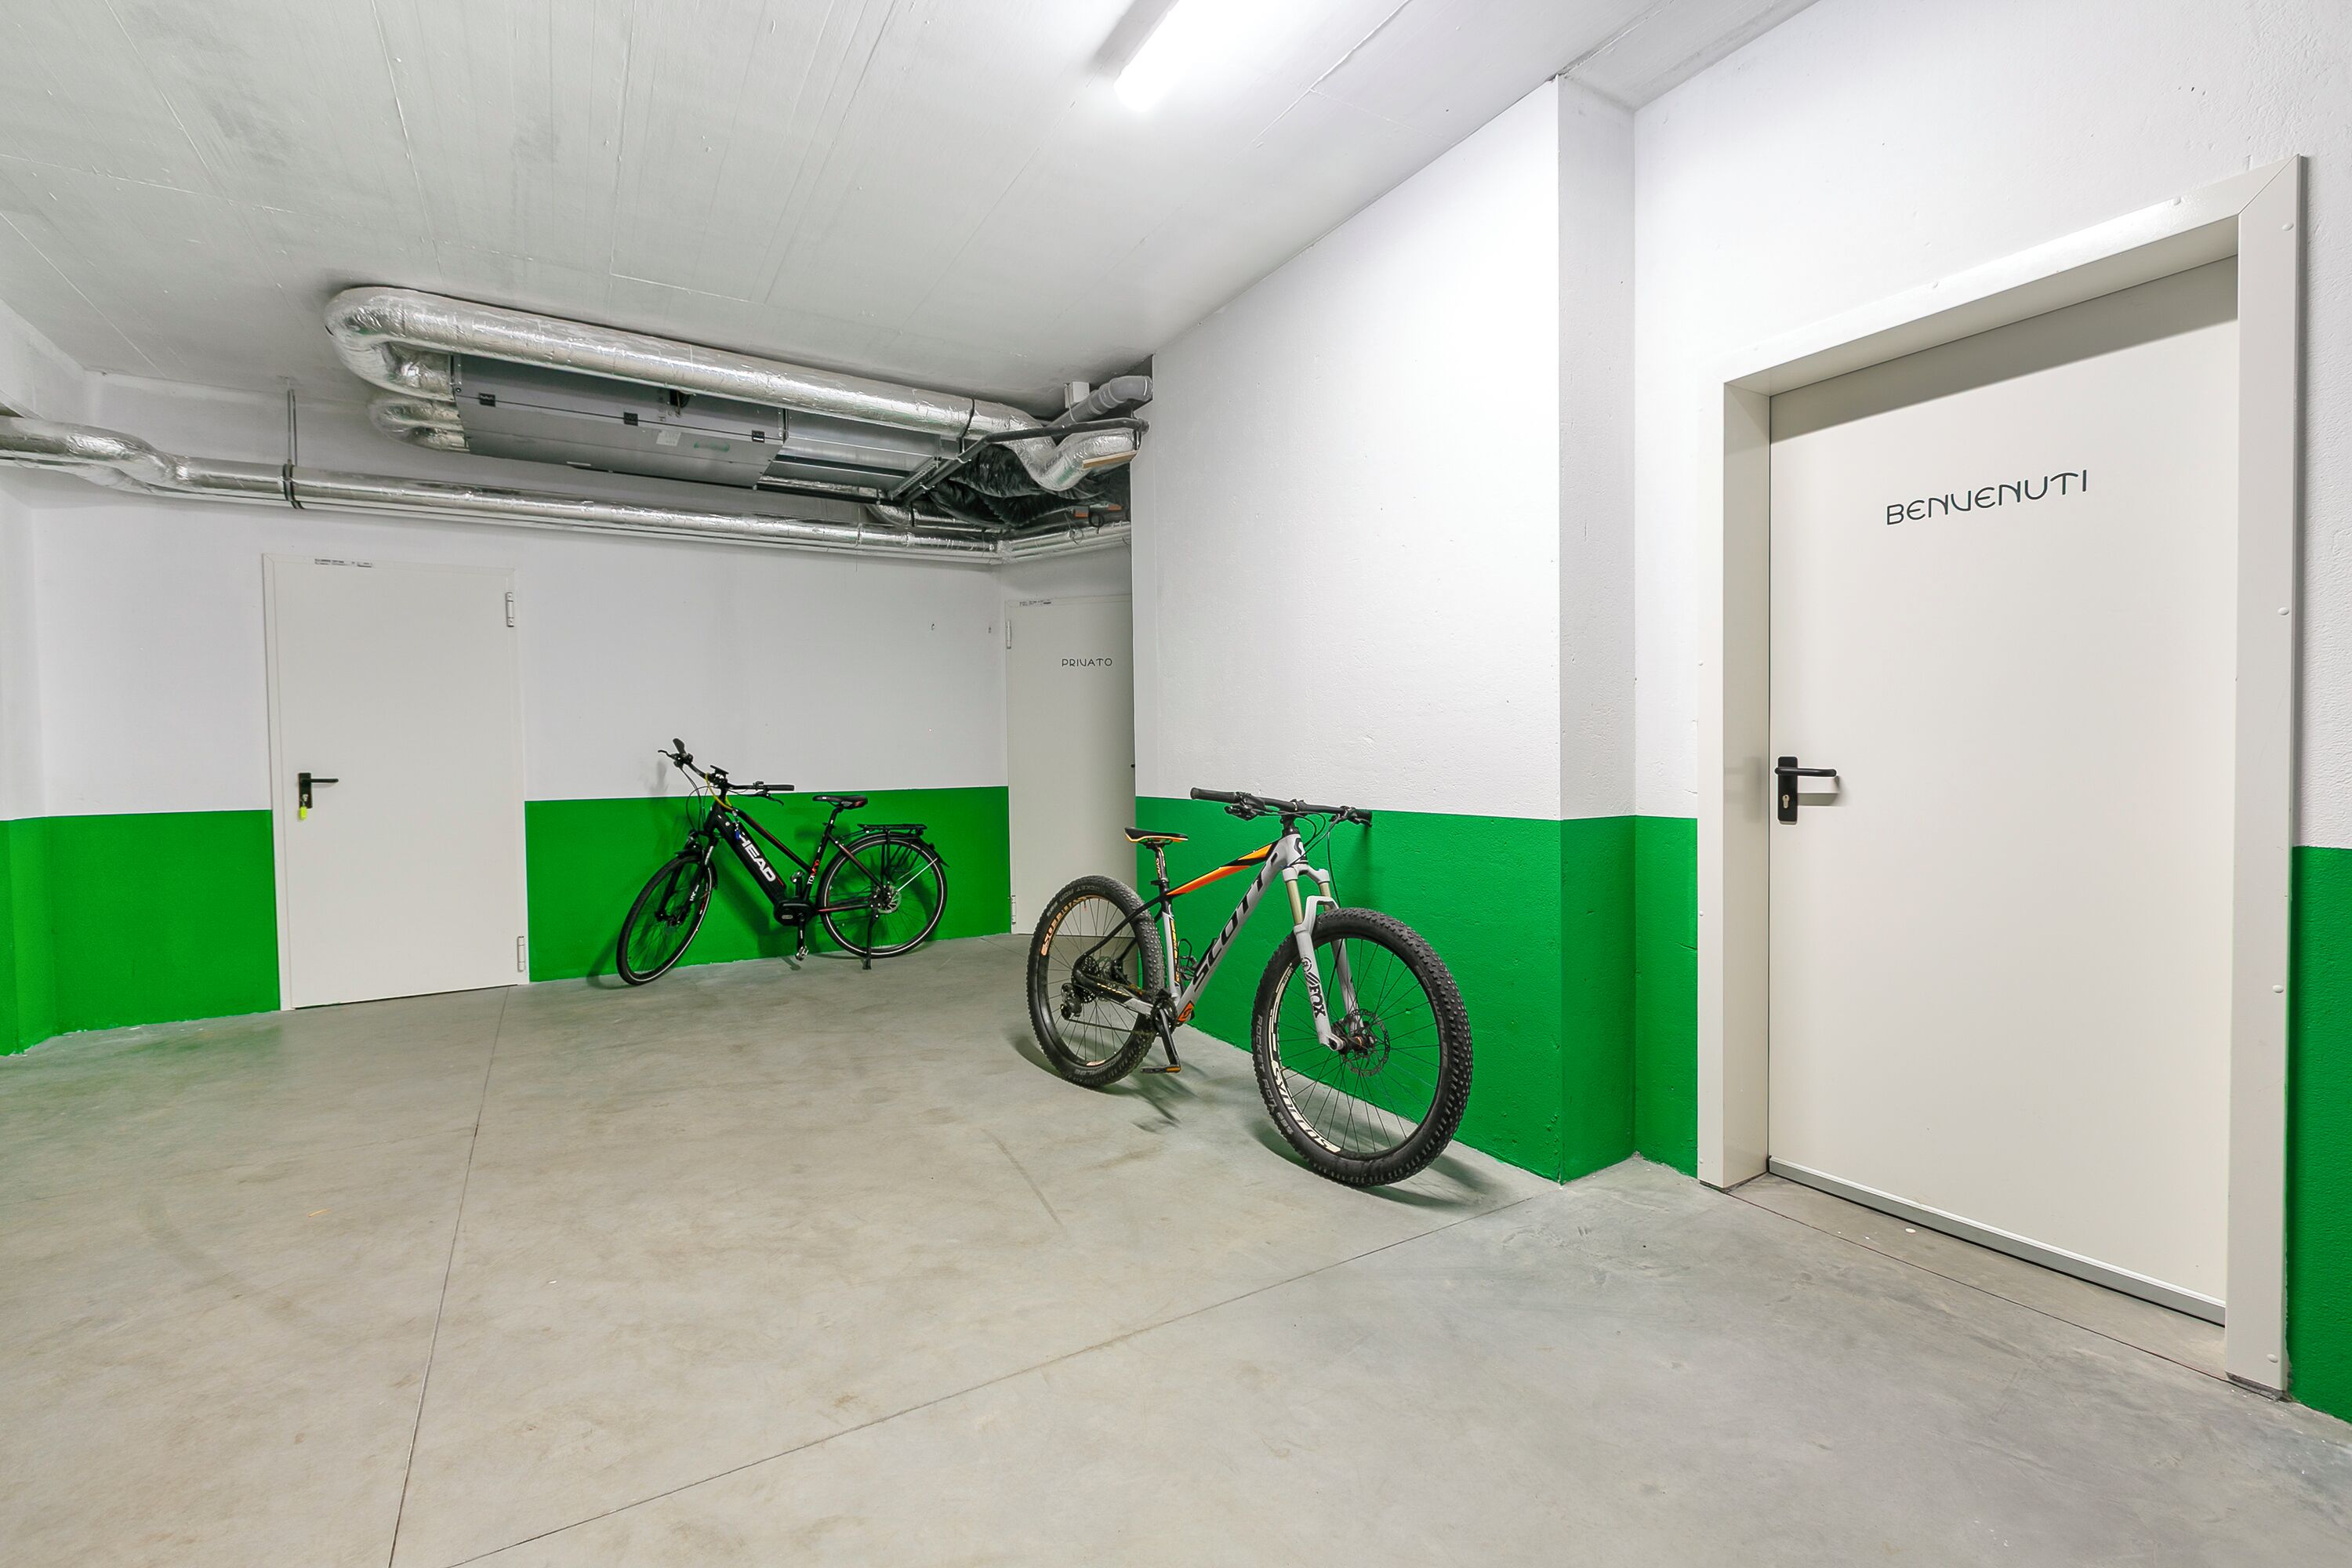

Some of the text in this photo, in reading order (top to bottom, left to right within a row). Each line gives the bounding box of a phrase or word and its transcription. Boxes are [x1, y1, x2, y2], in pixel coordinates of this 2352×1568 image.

[1886, 469, 2087, 525] BENVENUTI
[1062, 658, 1112, 667] PRIVATO
[739, 831, 776, 882] HEAD
[1192, 864, 1267, 993] SCOTT
[1309, 985, 1326, 1018] FOX
[1256, 1014, 1265, 1073] ROCKET
